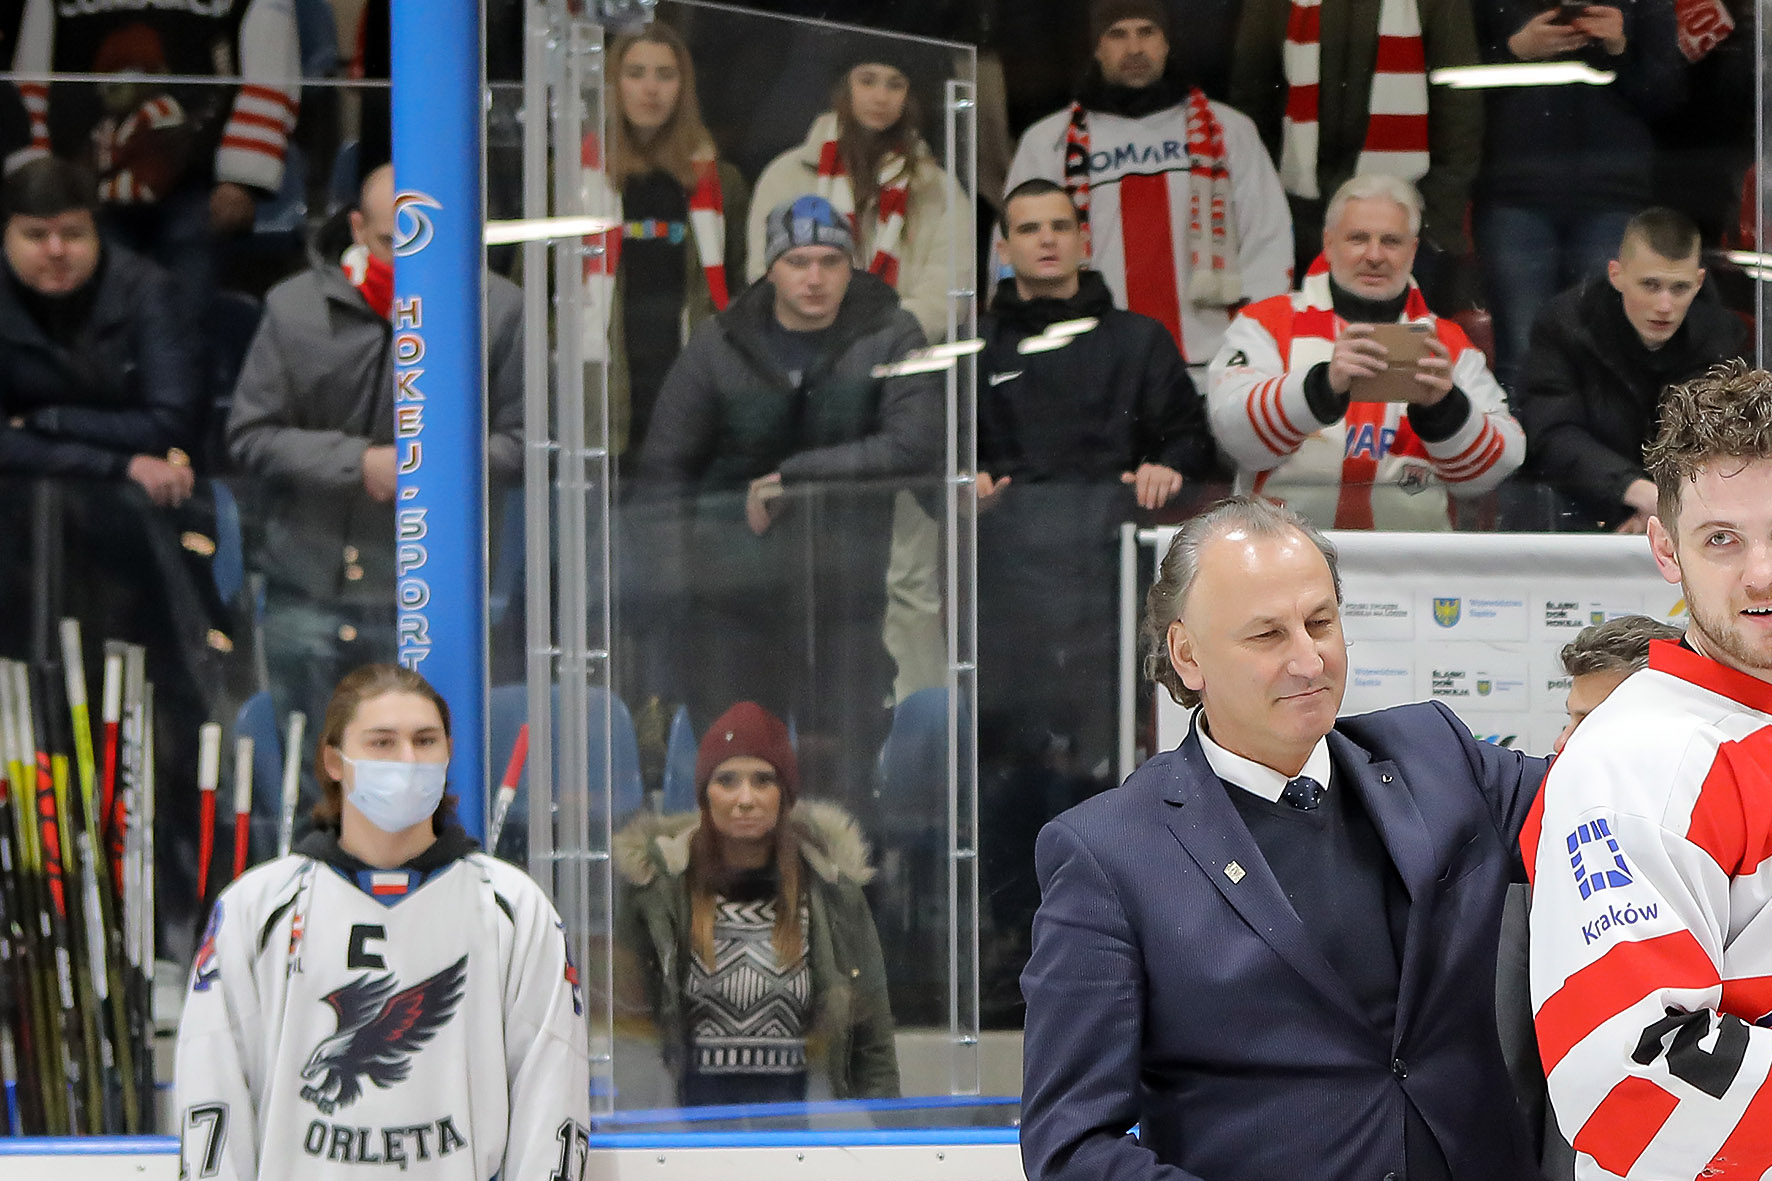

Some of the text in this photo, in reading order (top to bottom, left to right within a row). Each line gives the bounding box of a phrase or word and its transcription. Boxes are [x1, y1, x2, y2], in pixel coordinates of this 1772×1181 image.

[1088, 139, 1189, 173] OMAR
[1581, 902, 1659, 946] Kraków
[347, 924, 389, 970] C
[303, 1114, 469, 1173] ORLĘTA
